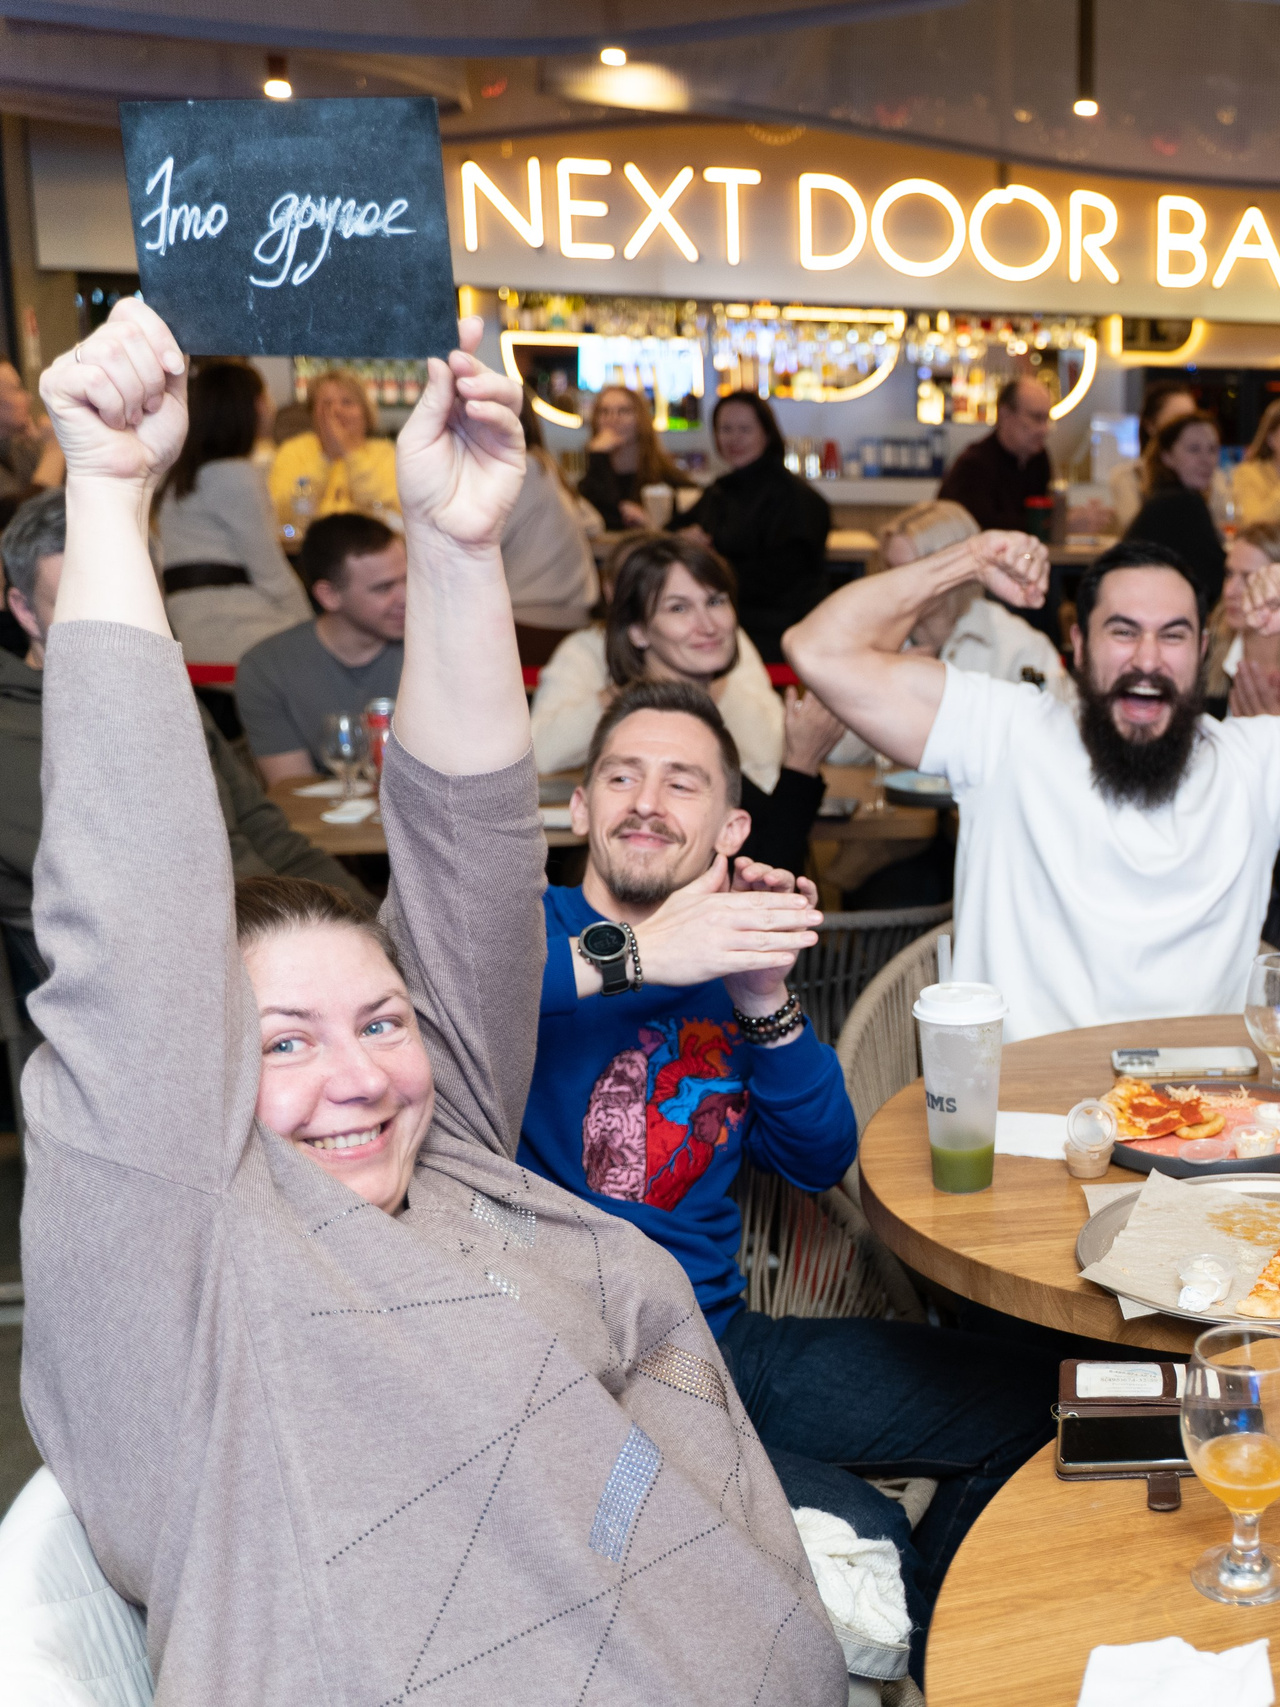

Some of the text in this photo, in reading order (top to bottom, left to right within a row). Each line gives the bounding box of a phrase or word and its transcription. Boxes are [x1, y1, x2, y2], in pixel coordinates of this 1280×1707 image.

[249, 192, 418, 288] другое
[459, 154, 763, 266] NEXT
[798, 172, 1121, 285] DOOR
